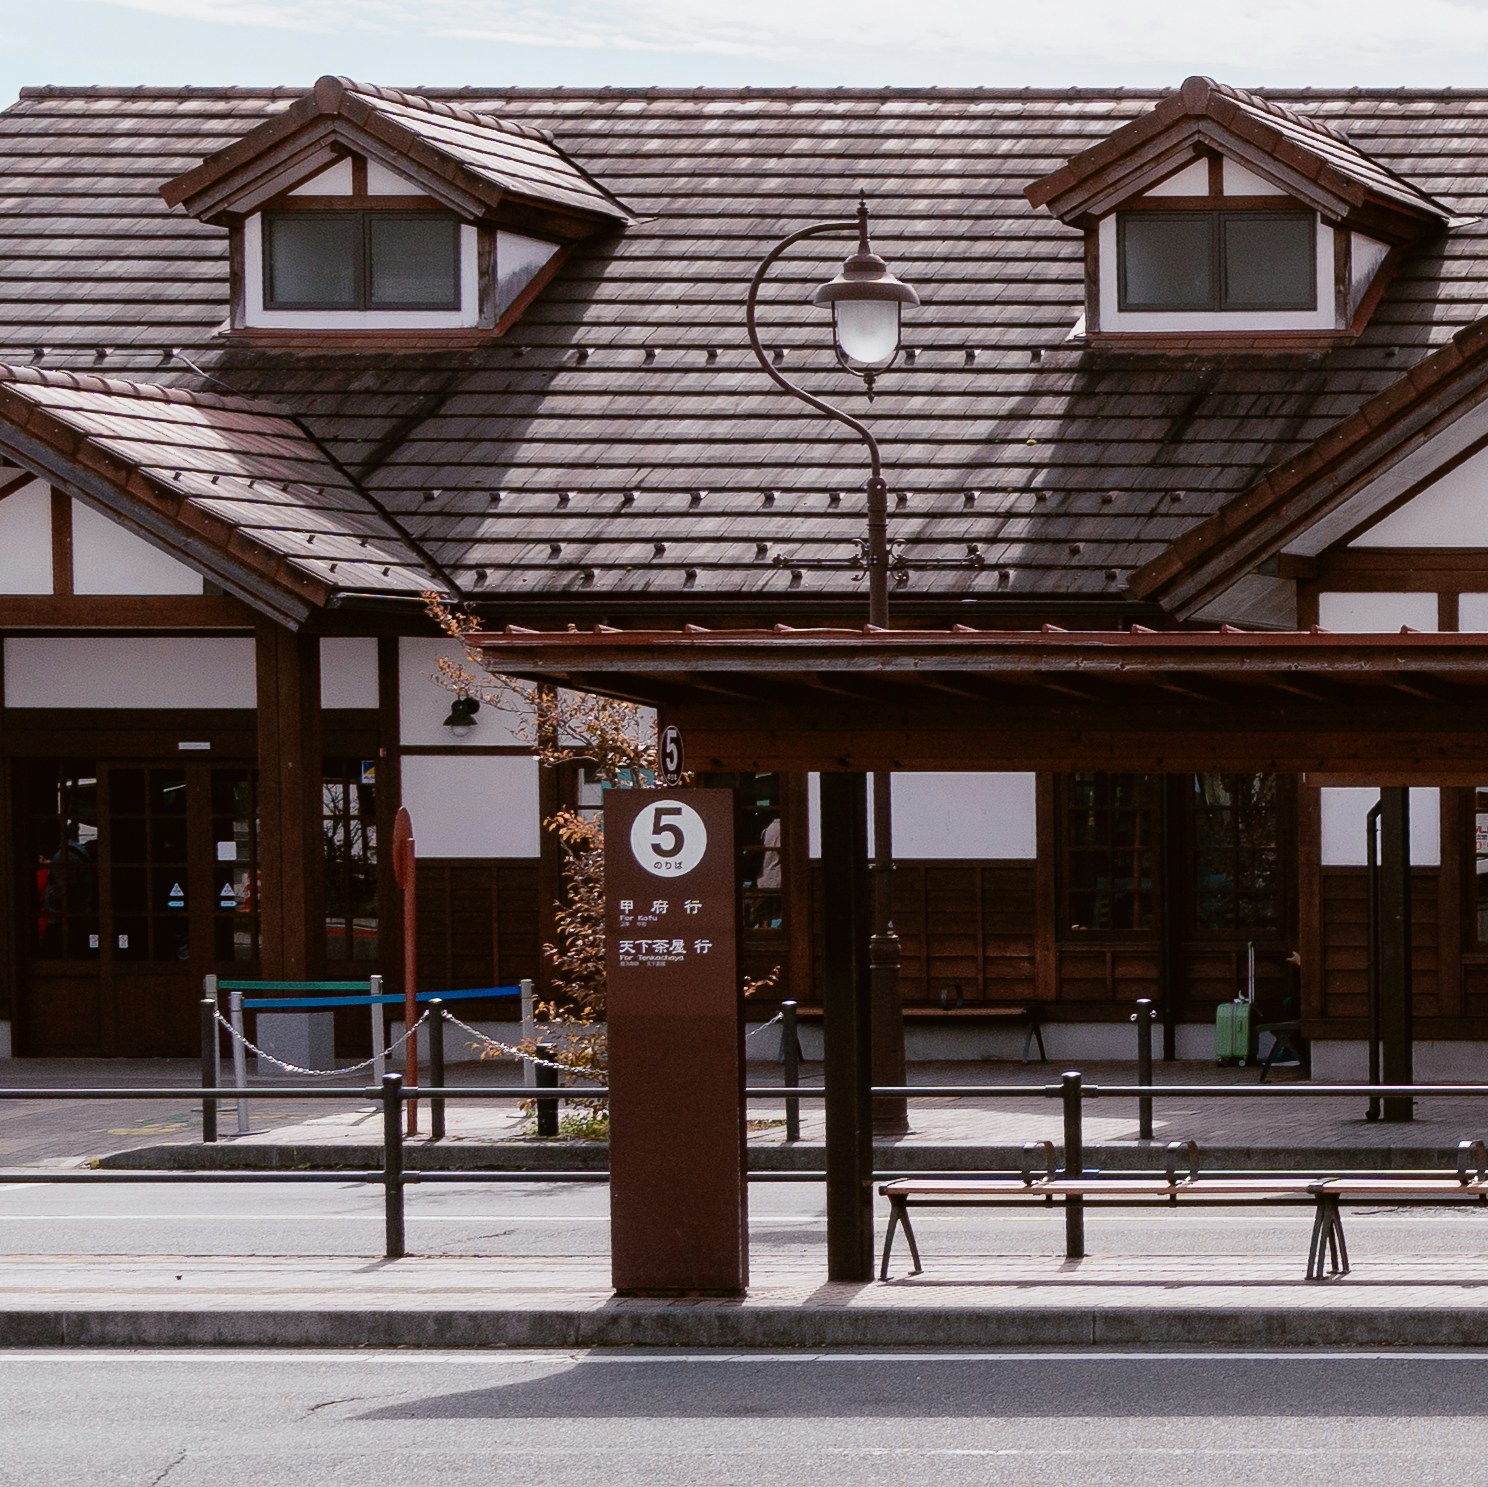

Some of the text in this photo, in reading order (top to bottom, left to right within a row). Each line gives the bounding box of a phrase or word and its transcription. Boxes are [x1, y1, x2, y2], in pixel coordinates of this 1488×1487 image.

[665, 729, 678, 771] 5
[651, 807, 685, 858] 5
[654, 861, 683, 870] のりば
[684, 899, 702, 914] 行
[619, 938, 713, 954] 天下茶屋 行
[638, 954, 684, 962] Tenkachaya
